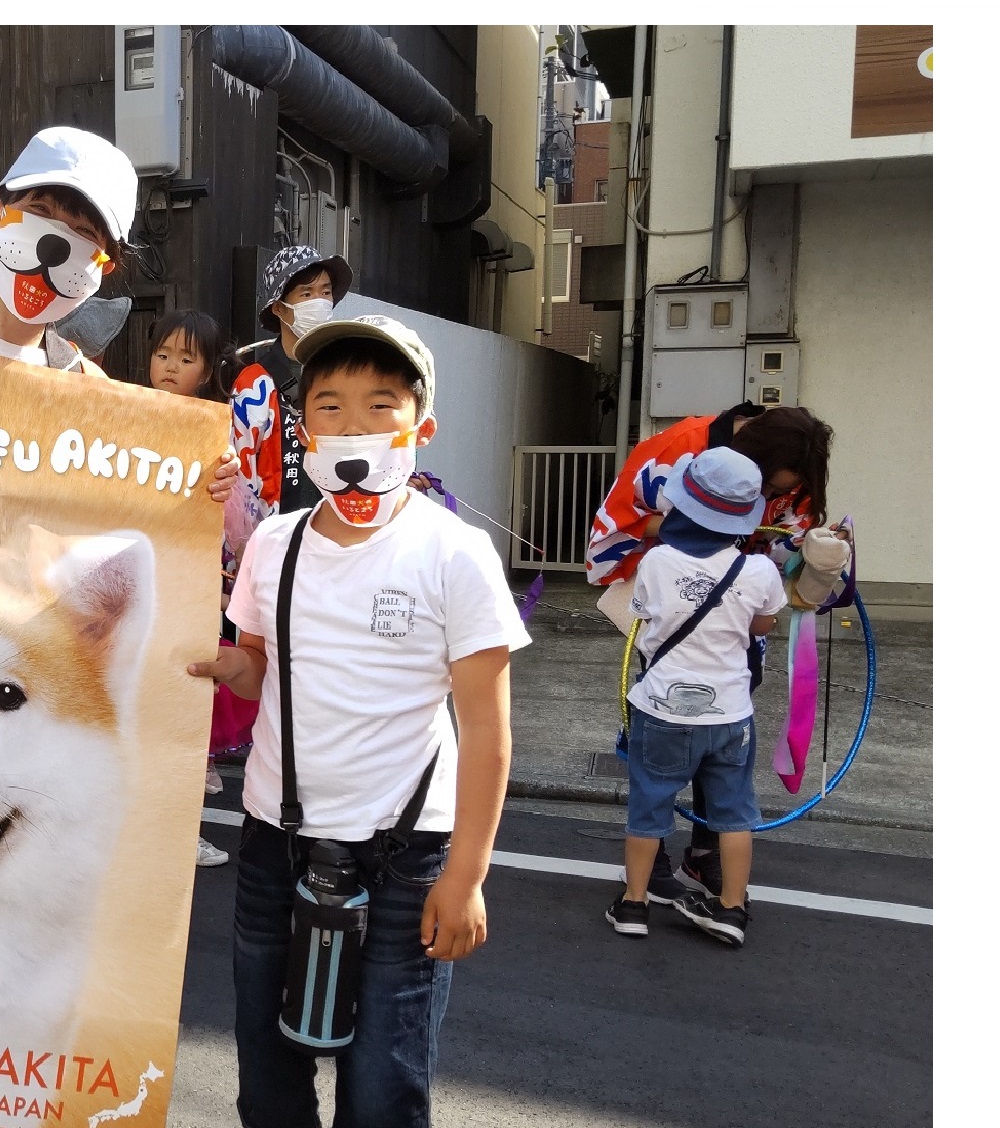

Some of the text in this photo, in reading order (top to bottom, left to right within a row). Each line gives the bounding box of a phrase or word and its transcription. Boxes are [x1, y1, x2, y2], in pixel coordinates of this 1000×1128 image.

[50, 428, 202, 498] AKITA!
[379, 597, 401, 606] BALL
[377, 621, 392, 631] LIE
